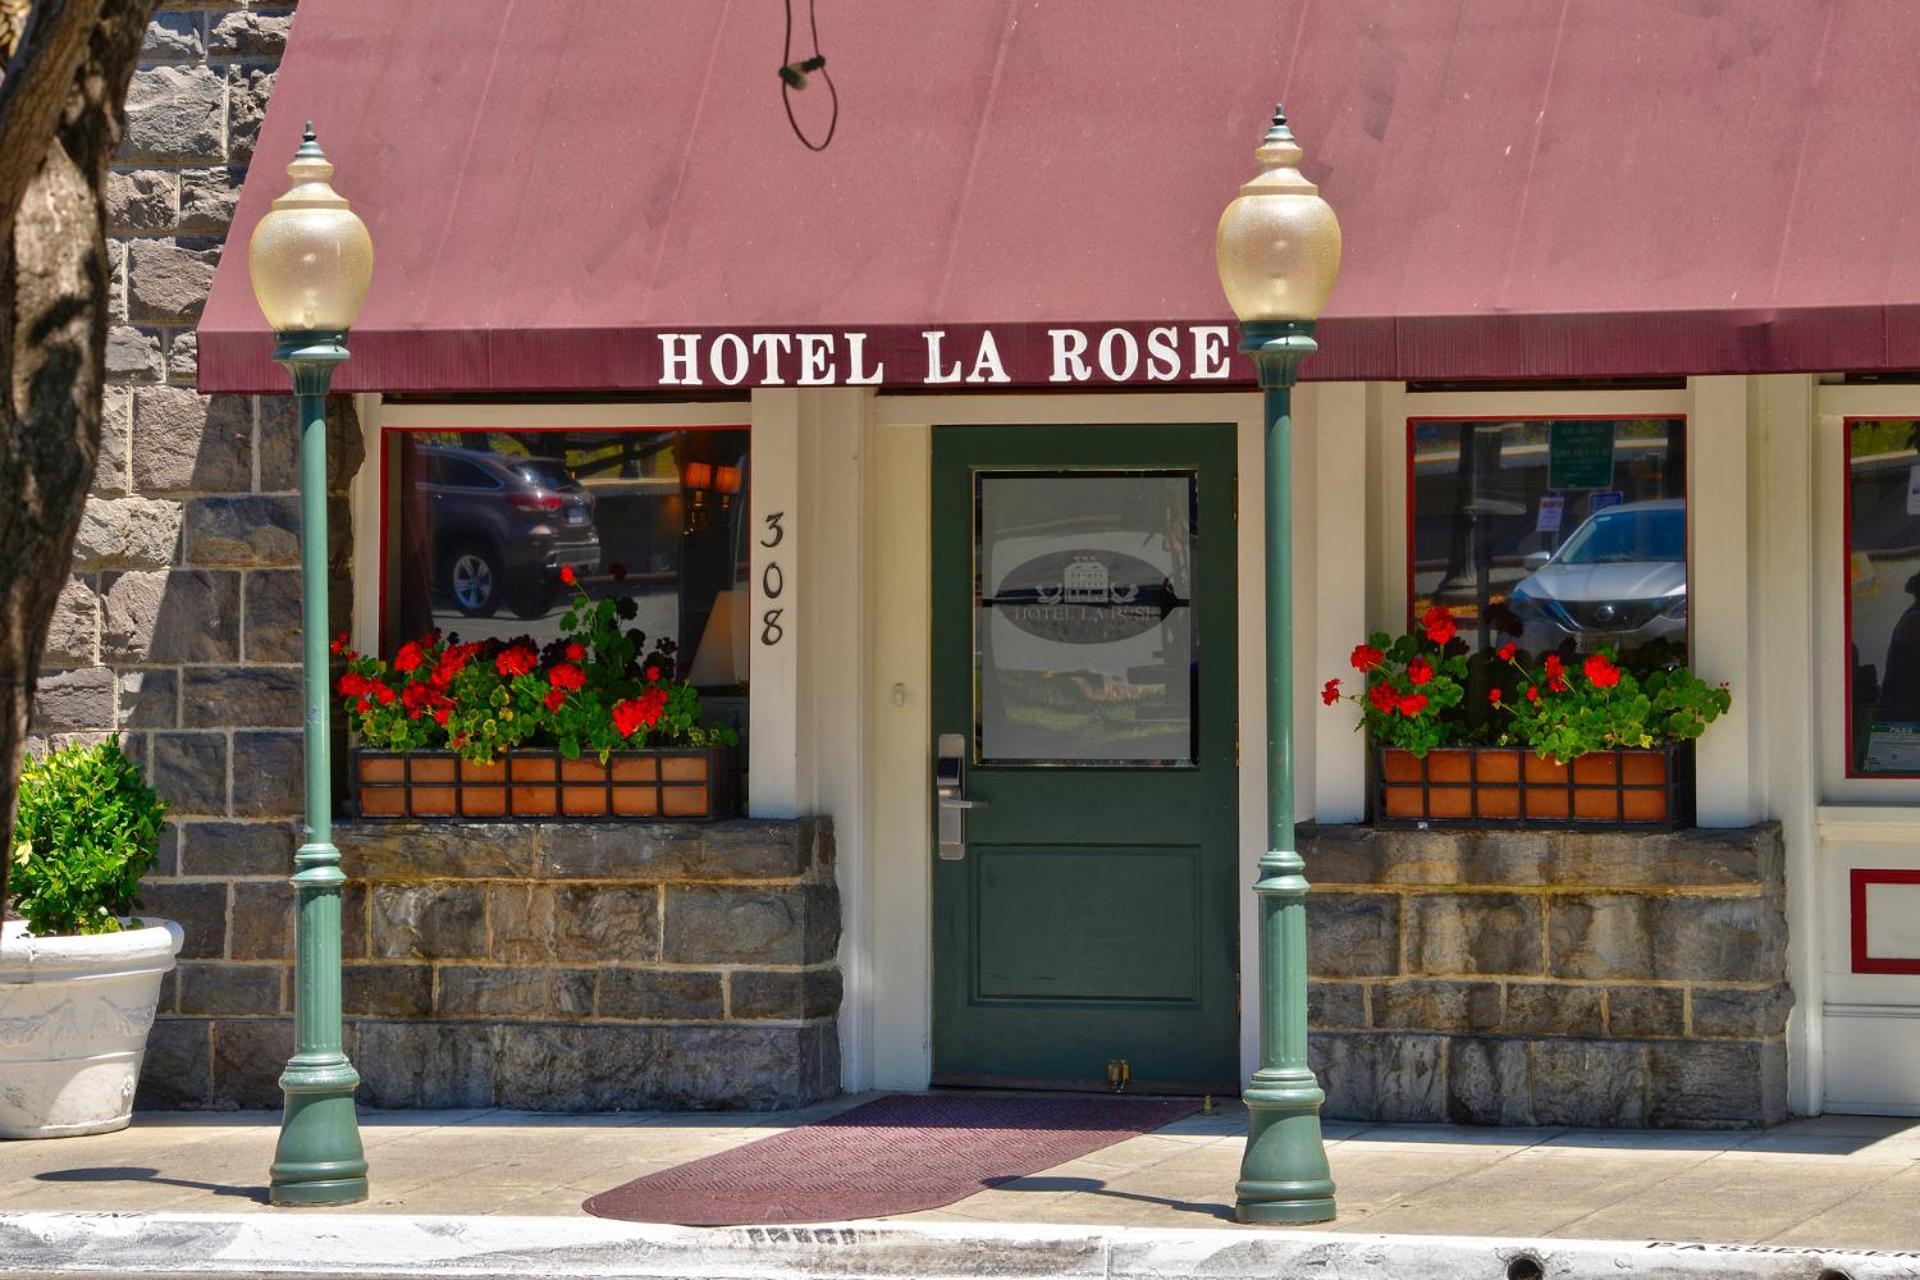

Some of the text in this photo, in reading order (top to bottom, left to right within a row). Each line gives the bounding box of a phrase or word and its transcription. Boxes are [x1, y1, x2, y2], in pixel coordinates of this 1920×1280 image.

[658, 326, 1231, 386] HOTEL LA ROSE
[760, 511, 784, 646] 308
[1015, 606, 1074, 621] HOTEL
